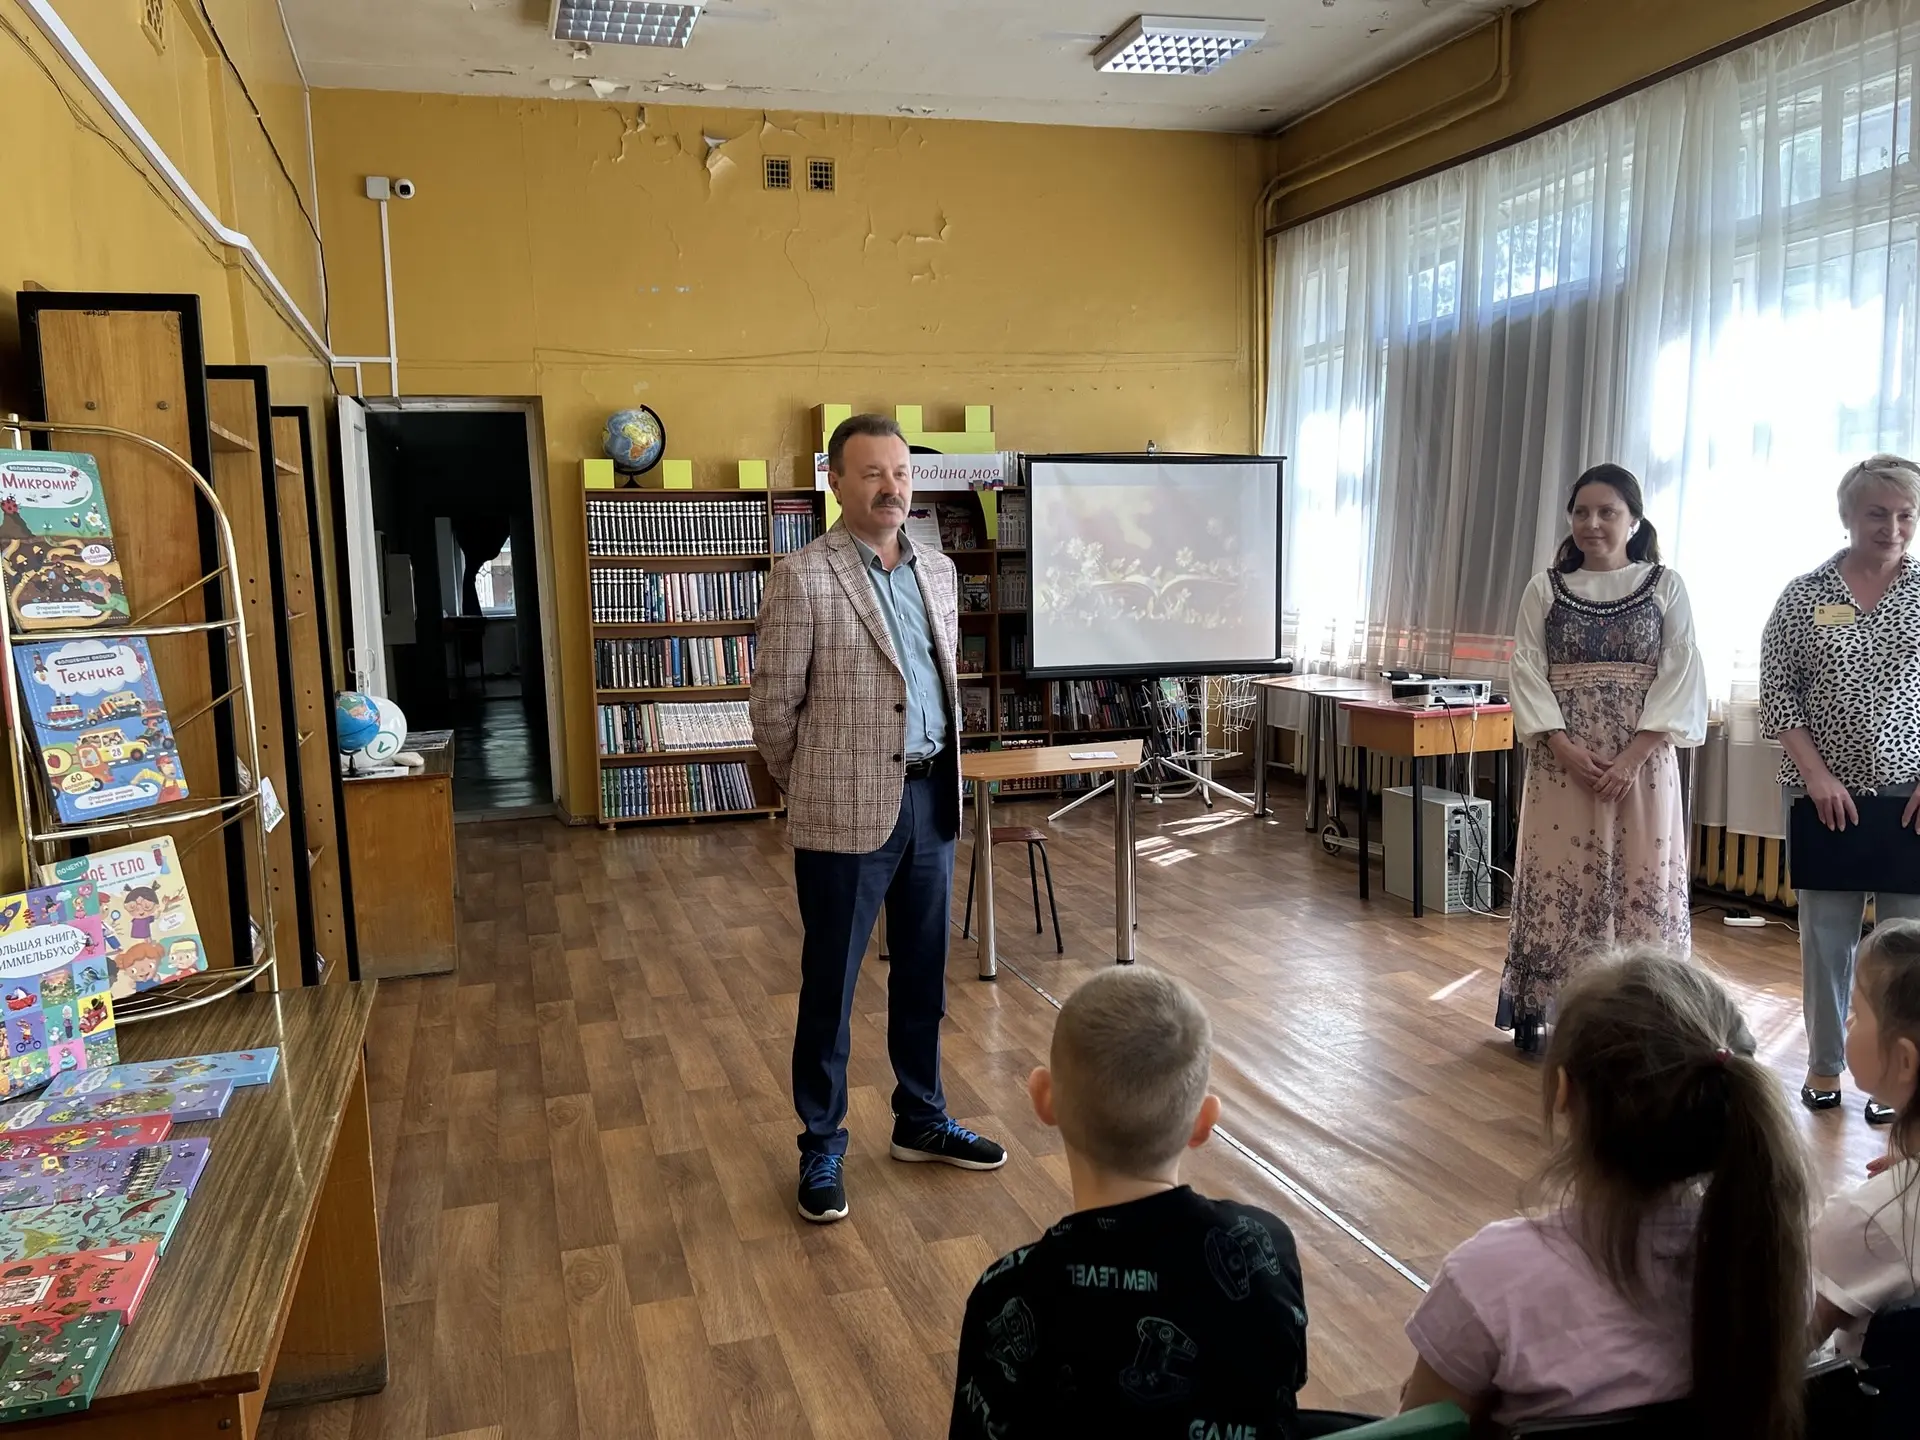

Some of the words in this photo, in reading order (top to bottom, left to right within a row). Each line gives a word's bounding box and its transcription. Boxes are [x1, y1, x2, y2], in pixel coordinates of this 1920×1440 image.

[911, 464, 967, 480] Родина
[970, 468, 1000, 480] моя
[89, 546, 101, 554] 60
[57, 665, 125, 684] Техника
[111, 748, 122, 757] 28
[70, 773, 82, 783] 60
[56, 859, 88, 875] ПОЧЕМУ?
[110, 857, 145, 878] ТЕЛО
[0, 938, 42, 956] ЛЬШАЯ
[44, 930, 78, 946] КНИГА
[1066, 1264, 1119, 1288] LEVEL
[1123, 1269, 1158, 1292] NEW
[1188, 1418, 1257, 1440] GAME
